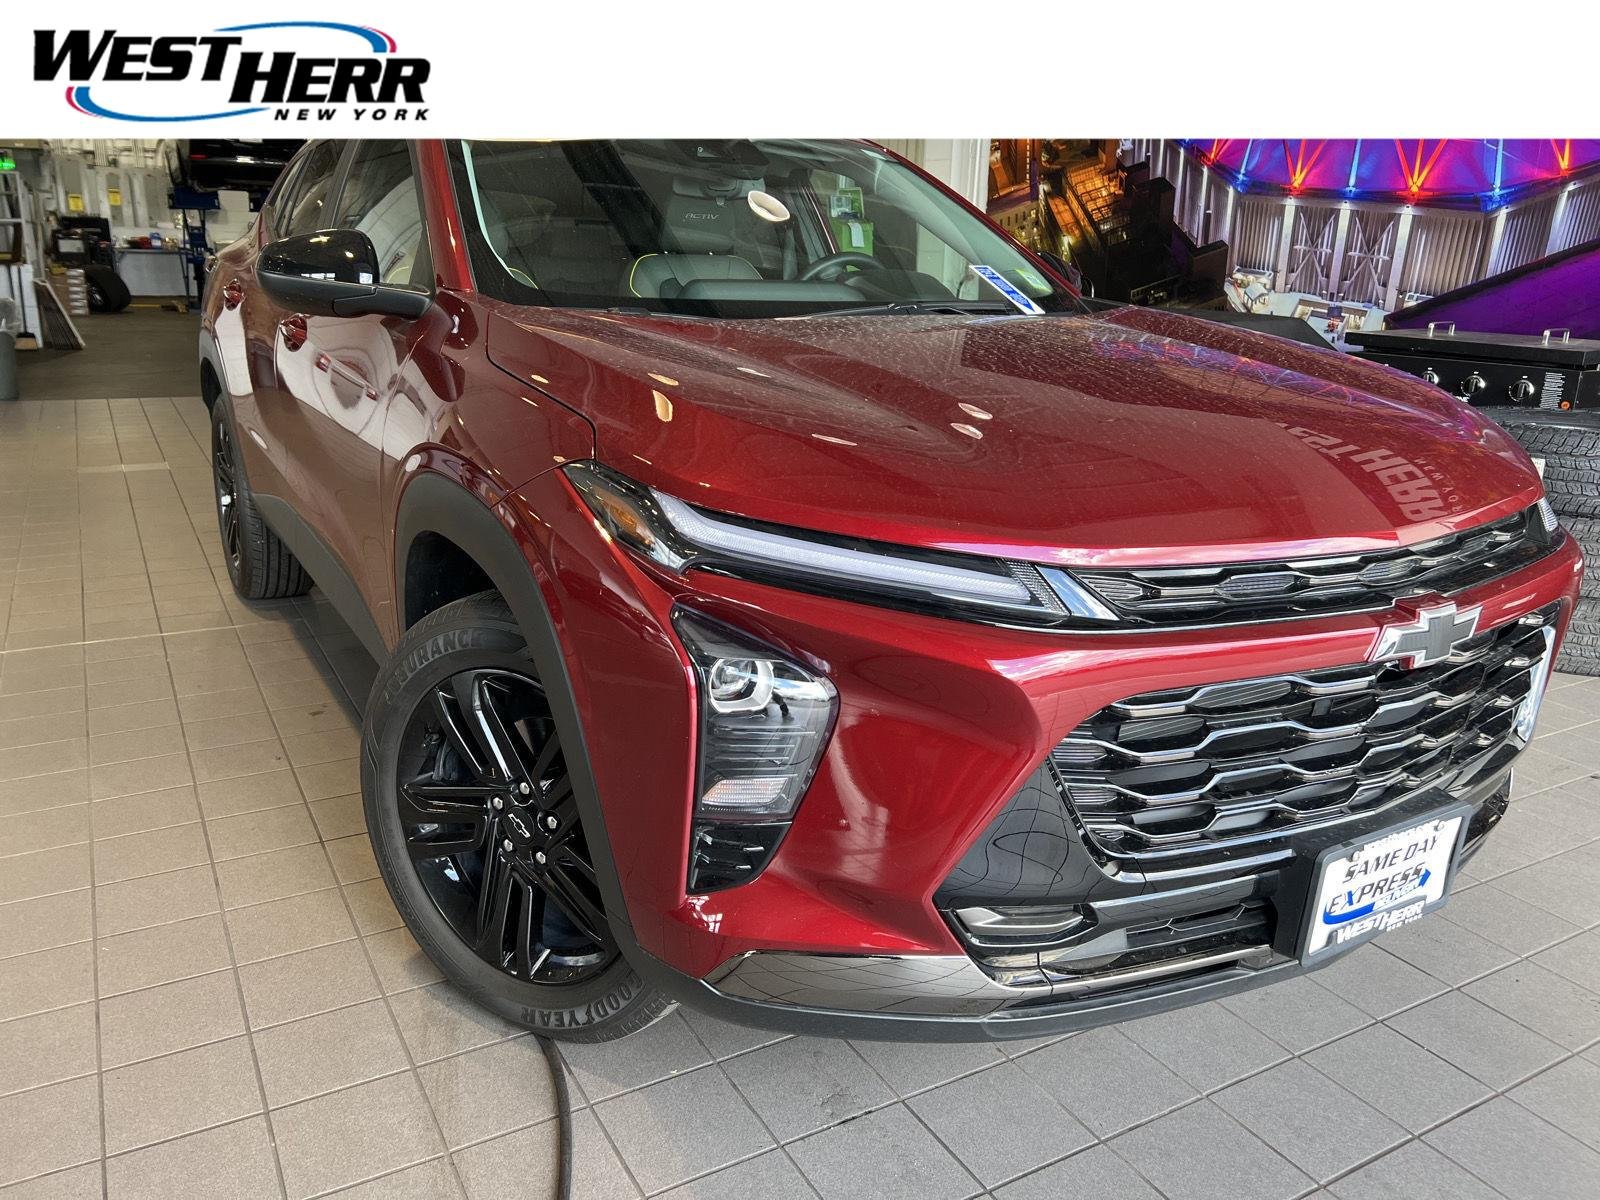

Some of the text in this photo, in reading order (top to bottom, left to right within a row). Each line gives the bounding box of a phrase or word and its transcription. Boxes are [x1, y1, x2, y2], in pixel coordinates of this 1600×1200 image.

[1342, 848, 1403, 884] SAME
[1403, 834, 1438, 862] DAY
[1328, 861, 1427, 915] EXPRESS
[1337, 900, 1426, 944] WEST HERR
[520, 972, 646, 1028] GOODYEAR
